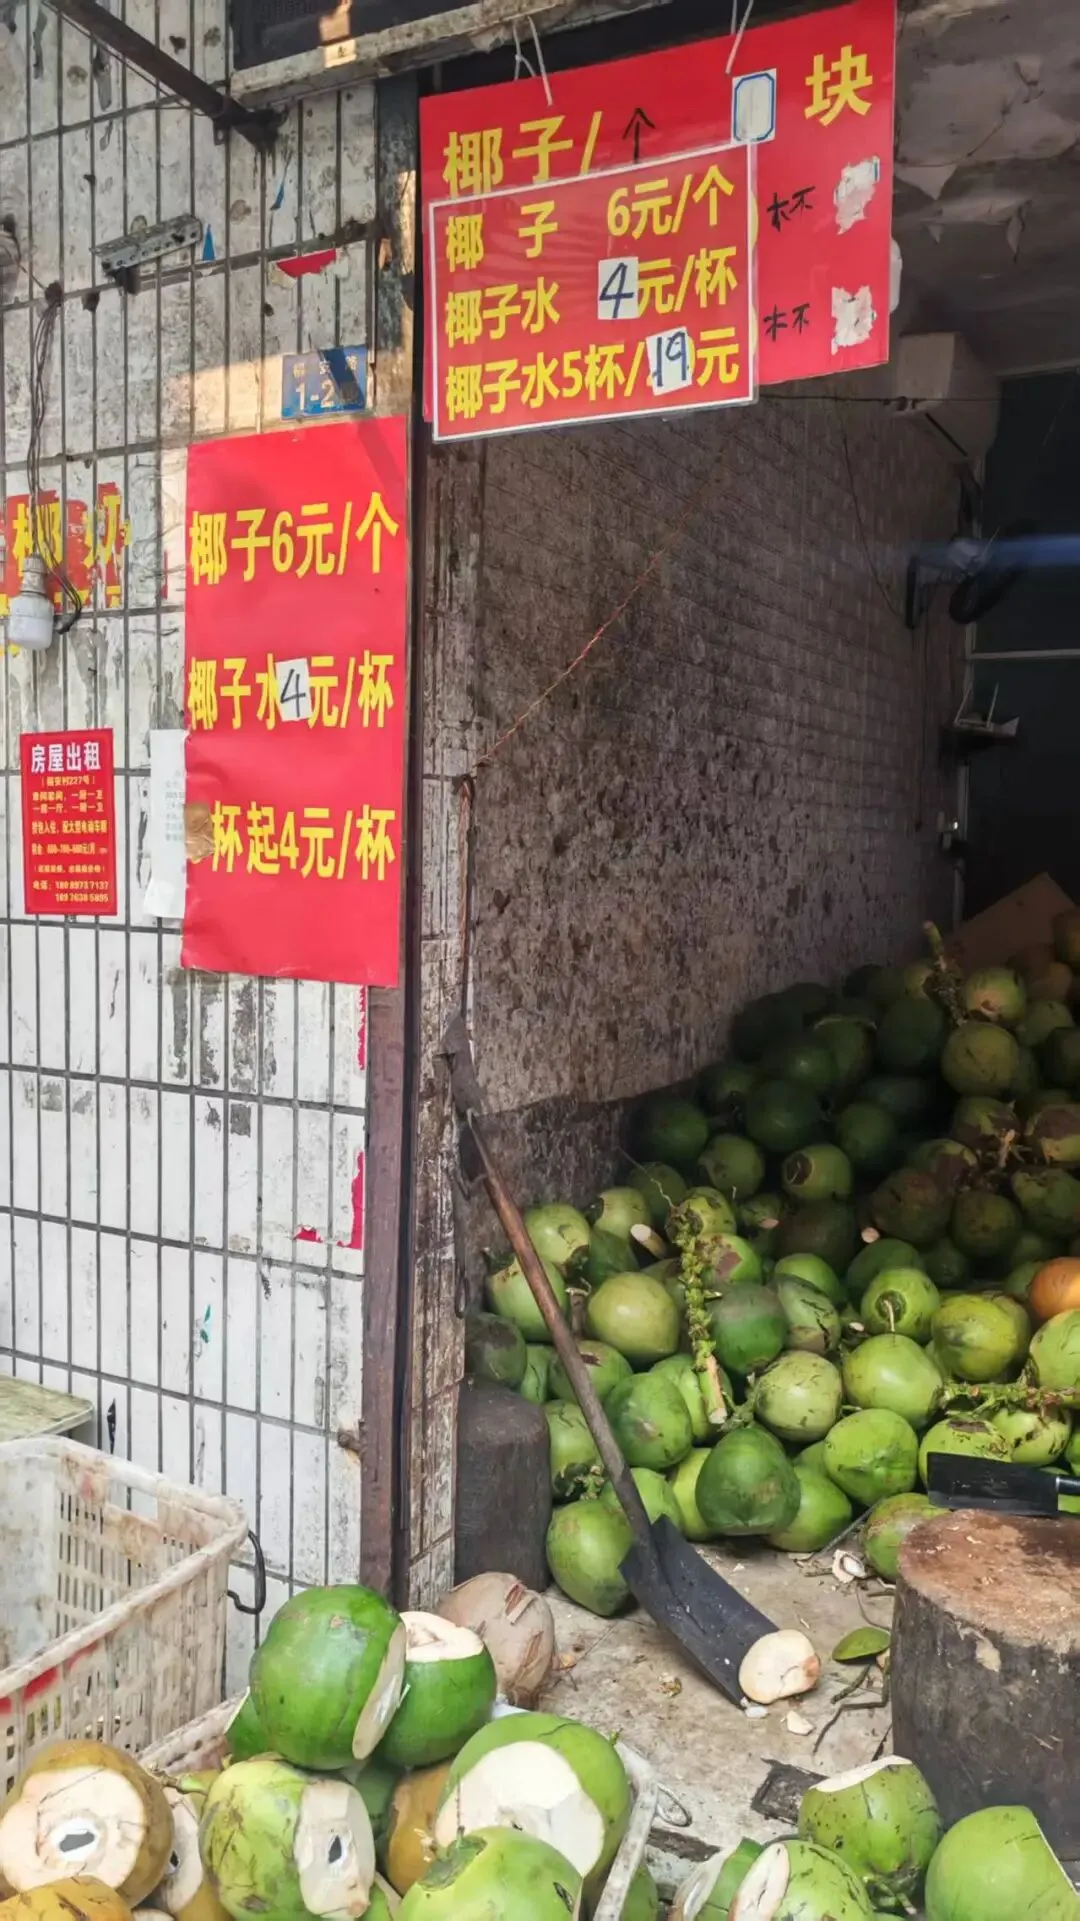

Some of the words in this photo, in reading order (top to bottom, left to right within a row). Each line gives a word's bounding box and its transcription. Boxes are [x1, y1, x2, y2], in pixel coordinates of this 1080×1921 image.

[804, 45, 873, 127] 块
[606, 164, 735, 240] 6元/个
[445, 277, 560, 348] 椰子水
[599, 246, 738, 319] 4元/杯
[189, 491, 399, 585] 椰子6元/个
[187, 650, 395, 731] 椰子水4元/杯
[31, 741, 101, 774] 房屋出租
[211, 800, 396, 881] 杯起4元/杯
